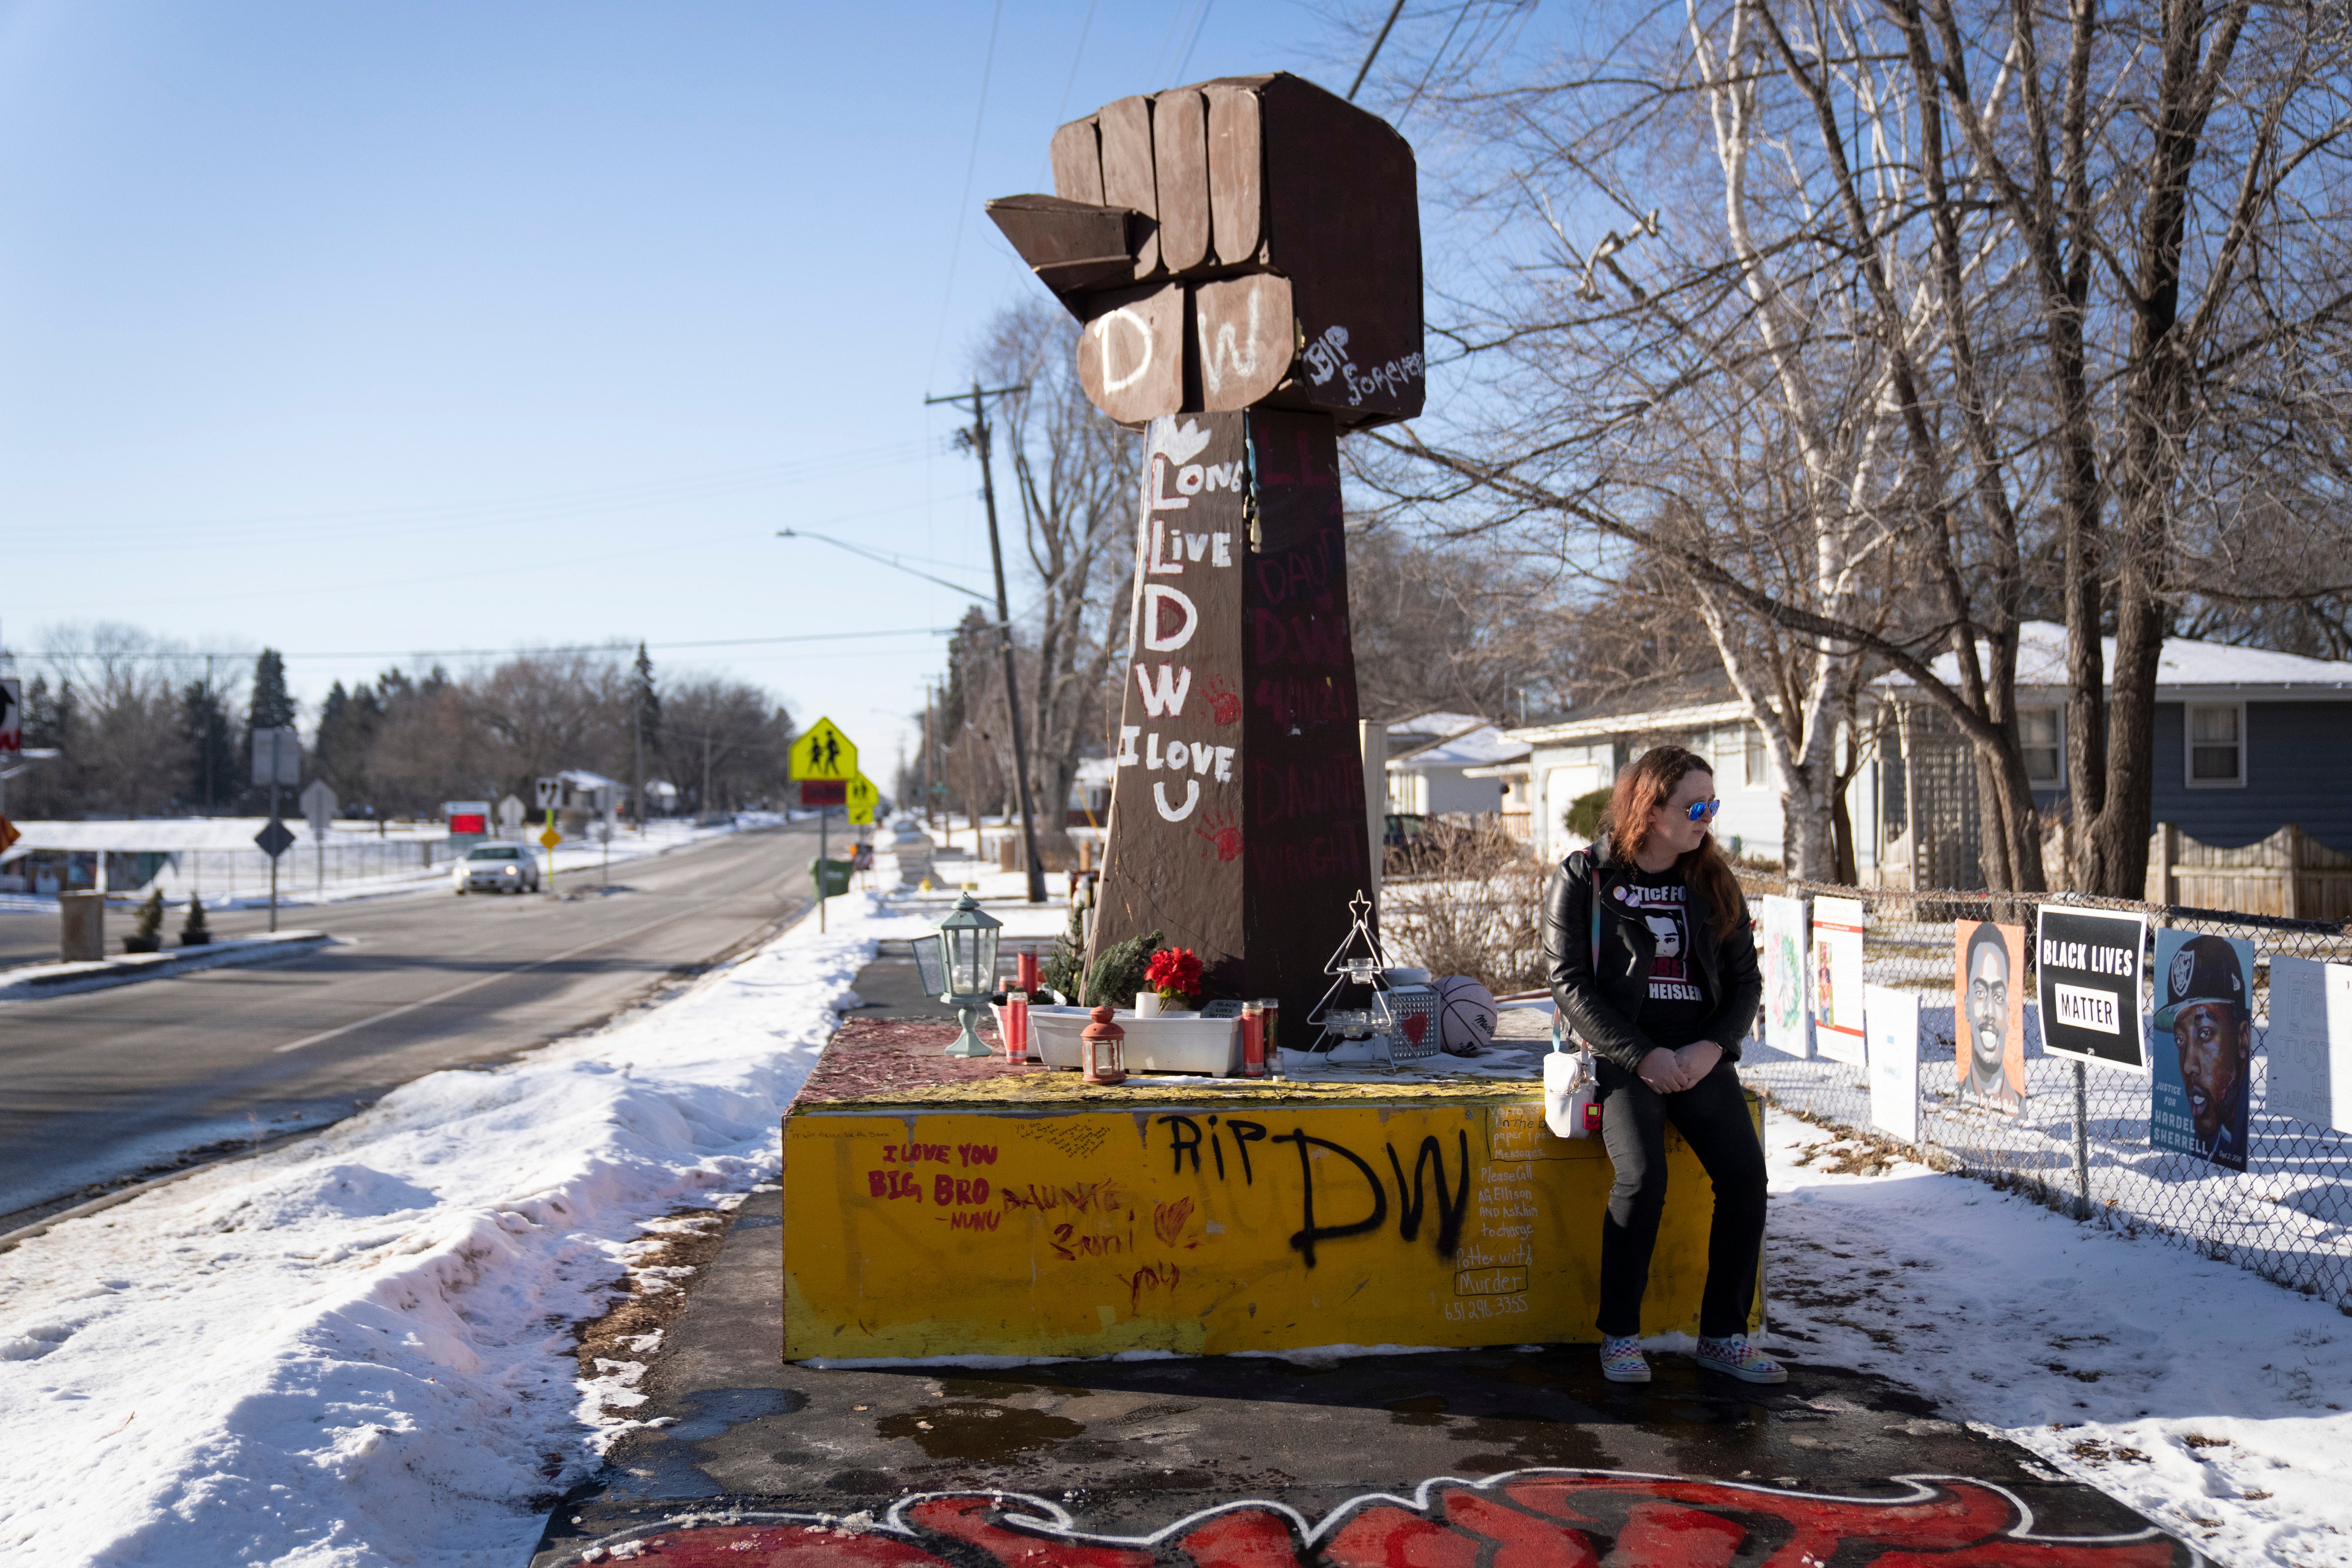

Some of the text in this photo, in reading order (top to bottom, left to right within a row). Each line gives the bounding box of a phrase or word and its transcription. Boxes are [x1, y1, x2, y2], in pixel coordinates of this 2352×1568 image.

[1093, 284, 1260, 395] D W
[1134, 662, 1192, 718] W
[1119, 725, 1236, 783] I LOVE
[1152, 779, 1200, 822] U
[2043, 939, 2133, 978] BLACK LIVES
[1648, 982, 1702, 1001] HEISLER
[2060, 993, 2113, 1026] MATTER
[2156, 1081, 2181, 1096] JUSTICE
[2164, 1097, 2177, 1107] FOR
[2155, 1109, 2196, 1134] HARDEL
[1494, 1131, 1523, 1149] paper
[2154, 1127, 2208, 1155] SHERRELL
[882, 1142, 998, 1168] I LOVE YOU
[1481, 1165, 1516, 1184] Please
[868, 1170, 989, 1206] BIG BRO
[1494, 1186, 1532, 1200] Ellison
[1481, 1221, 1534, 1240] to charge
[1456, 1243, 1533, 1269] Potter with
[1460, 1268, 1521, 1294] Murder
[1445, 1301, 1465, 1321] 651
